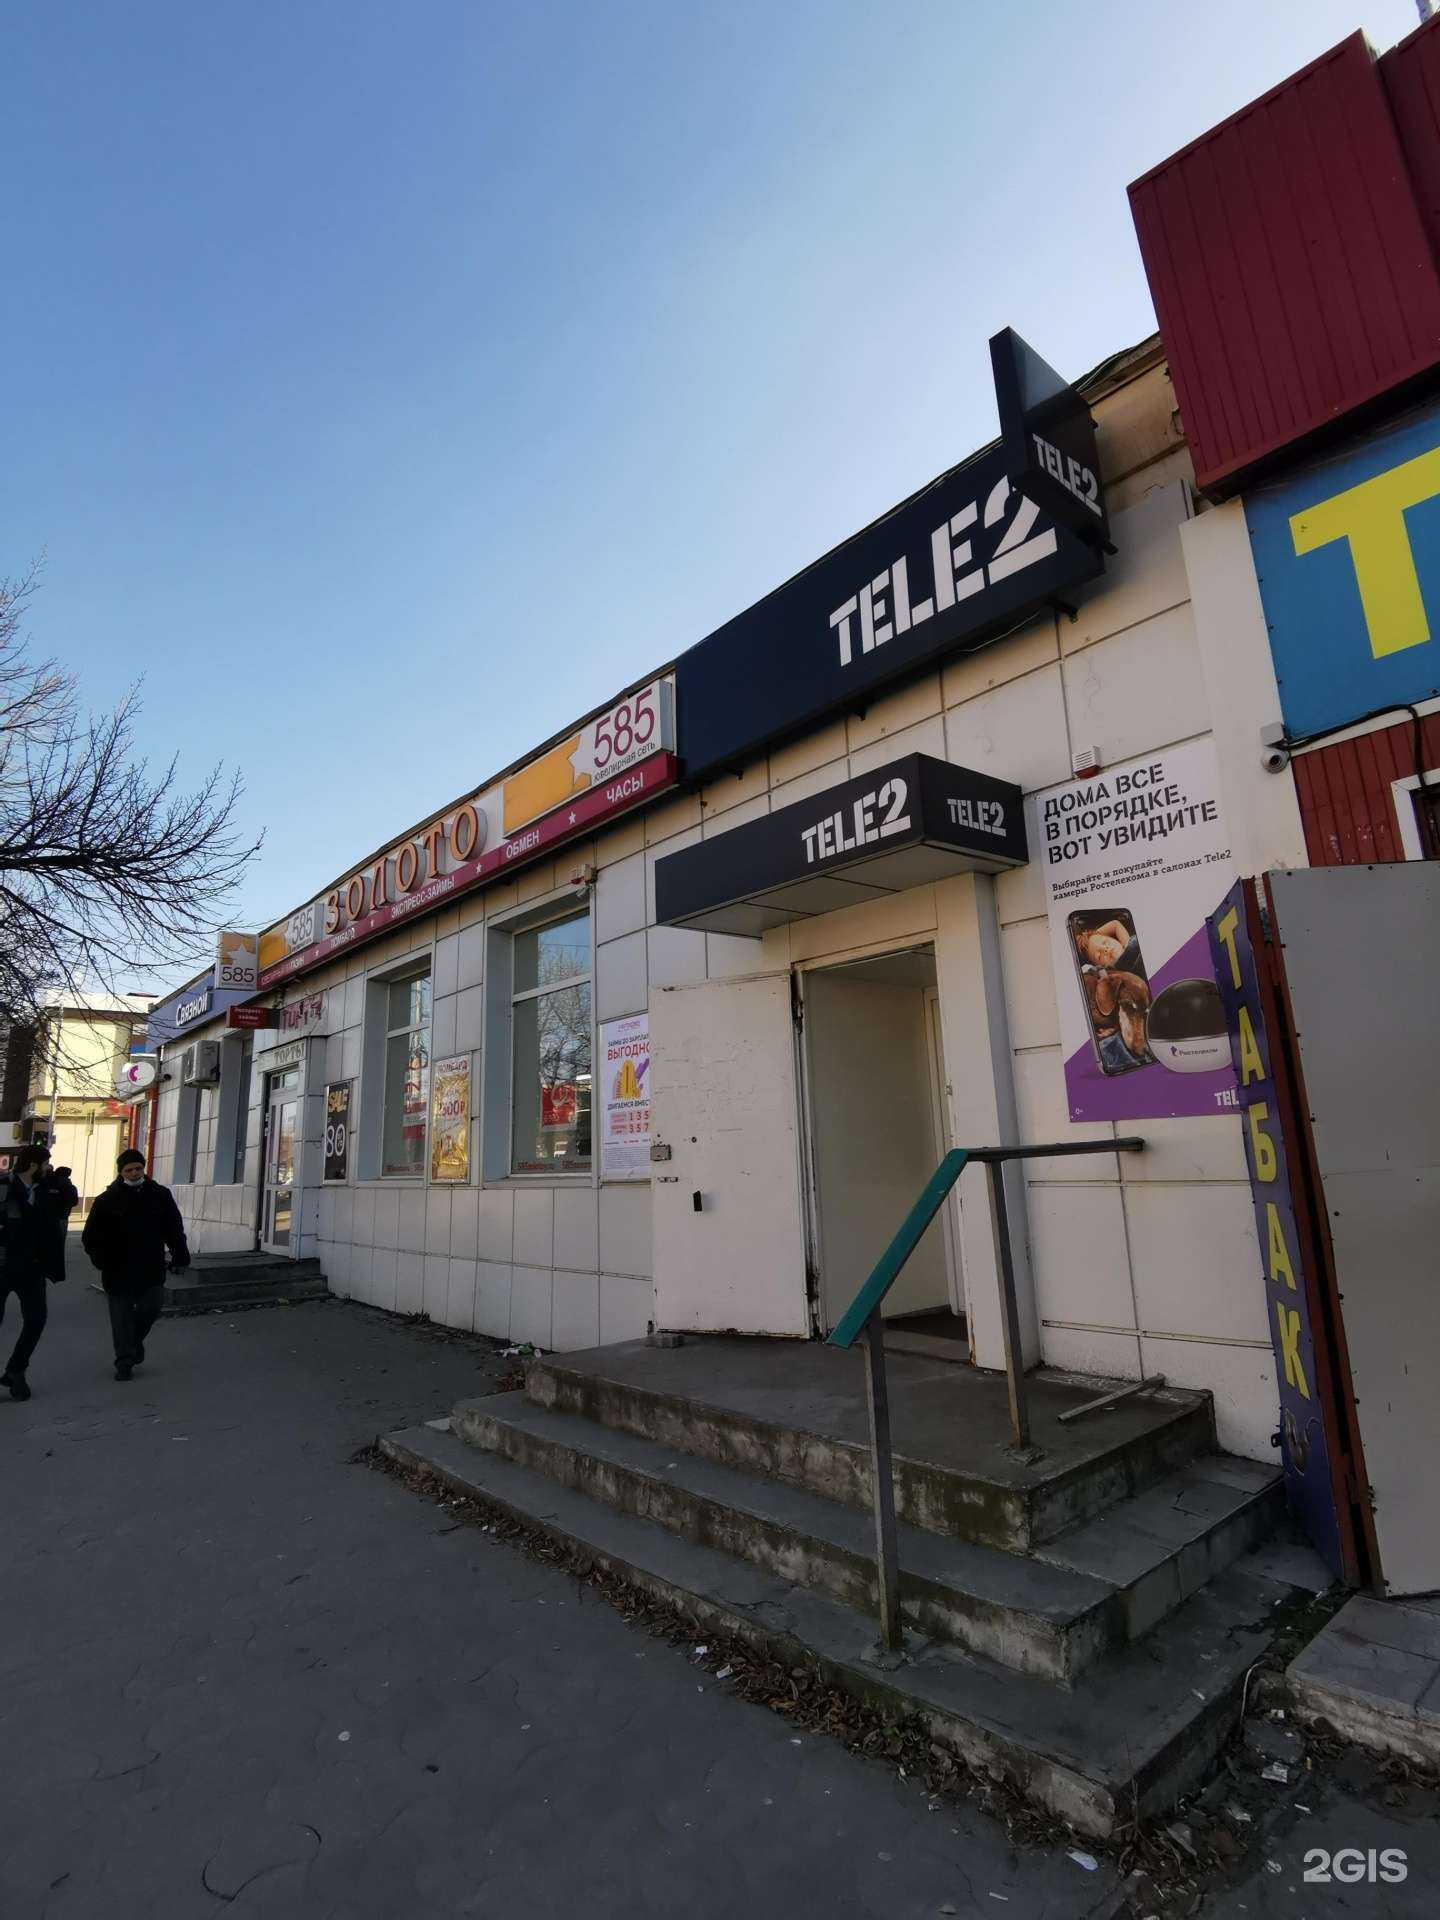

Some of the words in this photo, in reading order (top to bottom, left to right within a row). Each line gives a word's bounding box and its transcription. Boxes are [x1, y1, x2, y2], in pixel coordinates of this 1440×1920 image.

[1033, 433, 1103, 517] TELE2
[829, 475, 1058, 667] TELE2
[593, 688, 655, 768] 585
[801, 777, 911, 863] TELE2
[947, 798, 1007, 836] TELE2
[1044, 782, 1110, 822] ДОМА
[1115, 763, 1165, 795] ВСЕ
[1046, 822, 1060, 841] В
[1065, 784, 1187, 835] ПОРЯДКЕ,
[330, 927, 356, 948] ЛОМБАРД
[391, 876, 455, 919] ЭКСПРЕСС-ЗАЙМЫ
[506, 830, 540, 858] ОБМЕН
[606, 772, 644, 804] ЧАСЫ
[1048, 835, 1092, 864] ВОТ
[1097, 800, 1218, 850] УВИДИТЕ
[325, 804, 482, 935] ЗОЛОТО
[1052, 873, 1102, 892] Выбирайте
[1104, 871, 1110, 880] и
[1112, 857, 1163, 877] покупайте
[1053, 887, 1088, 901] камеры
[1090, 871, 1150, 892] Ростелекома
[1153, 868, 1159, 876] в
[1161, 858, 1202, 874] салонах
[1204, 849, 1232, 864] Tele2
[290, 908, 313, 945] 585
[221, 966, 255, 983] 585
[1214, 1089, 1240, 1107] TEL
[1217, 906, 1311, 1400] ТАБАК
